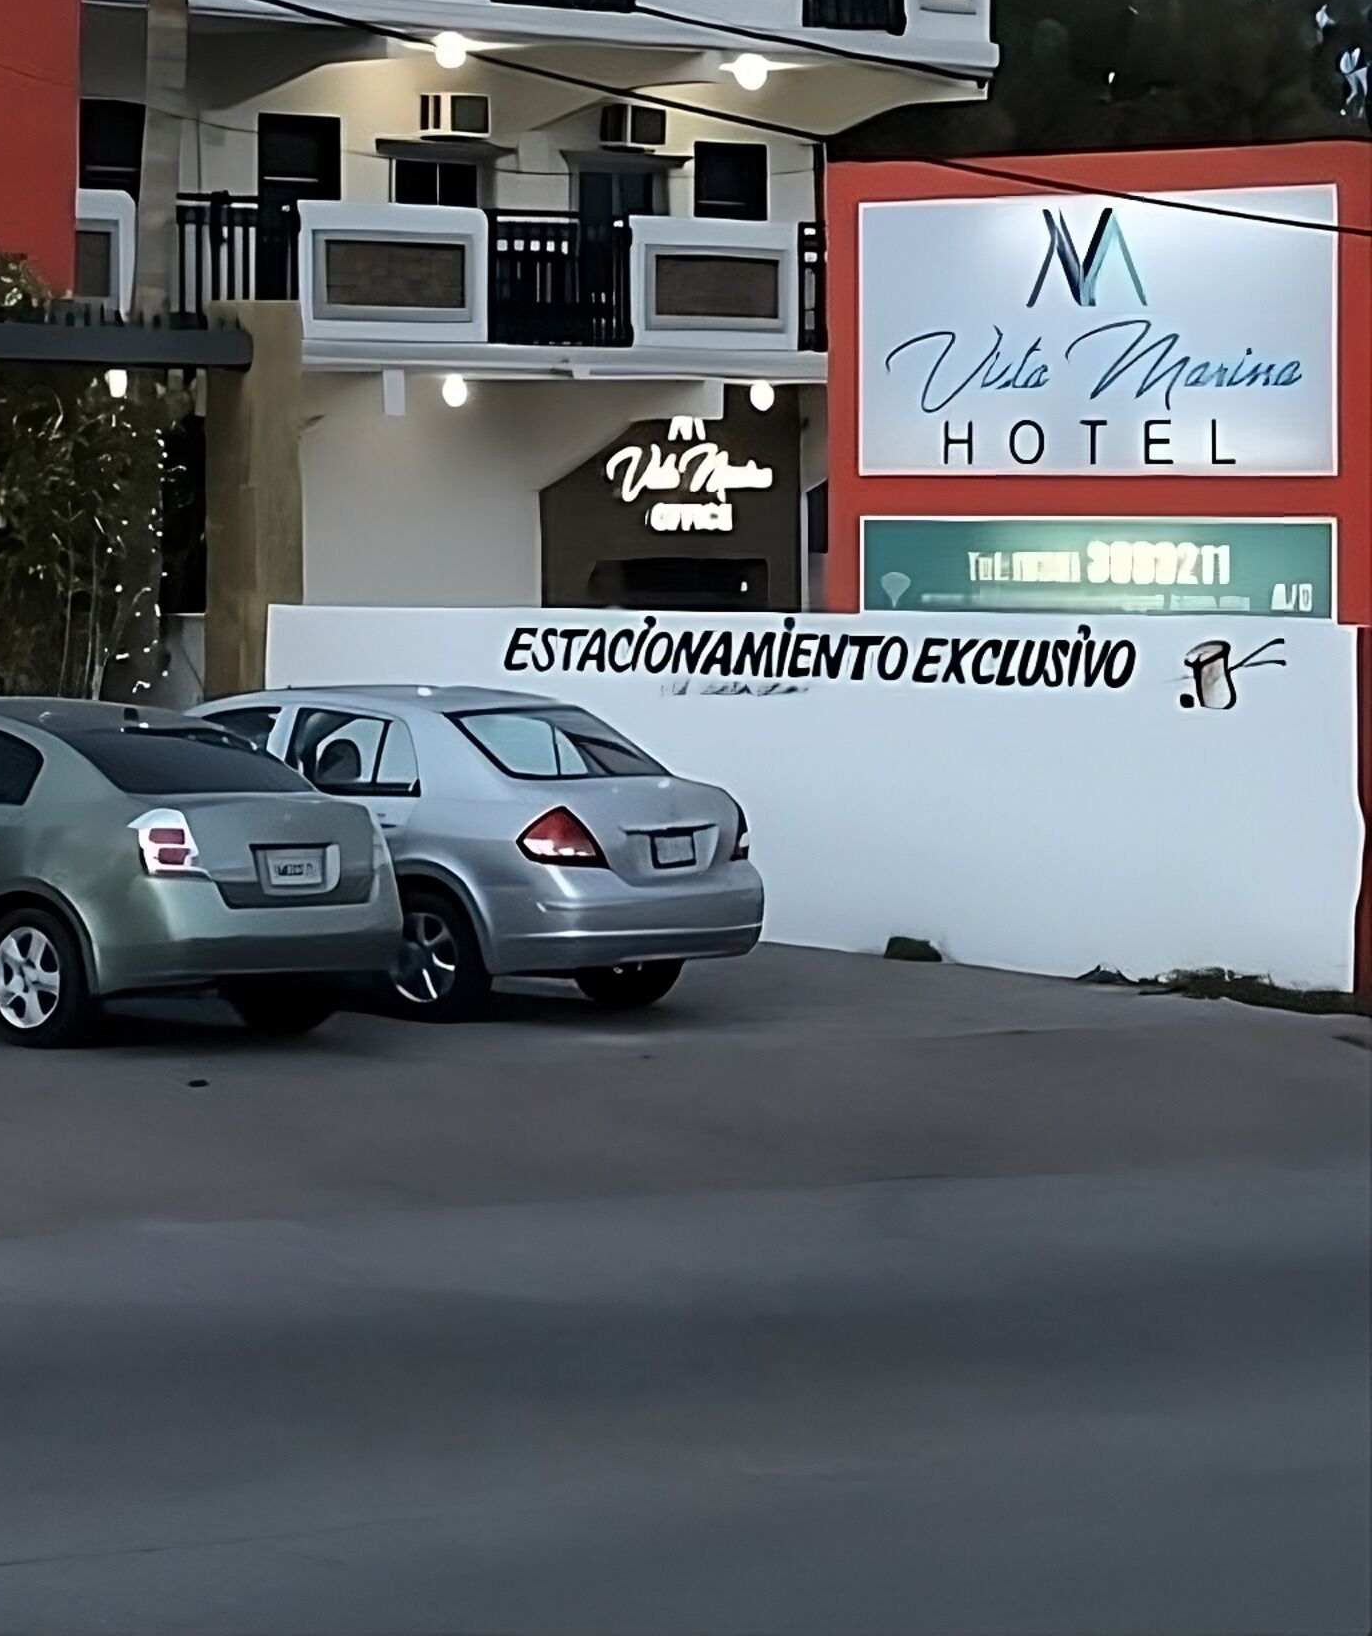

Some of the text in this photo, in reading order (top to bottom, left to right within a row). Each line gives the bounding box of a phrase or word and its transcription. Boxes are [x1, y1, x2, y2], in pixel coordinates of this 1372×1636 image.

[1065, 319, 1302, 411] Marina
[943, 419, 1237, 465] HOTEL
[911, 624, 1136, 689] EXCLUSIVO
